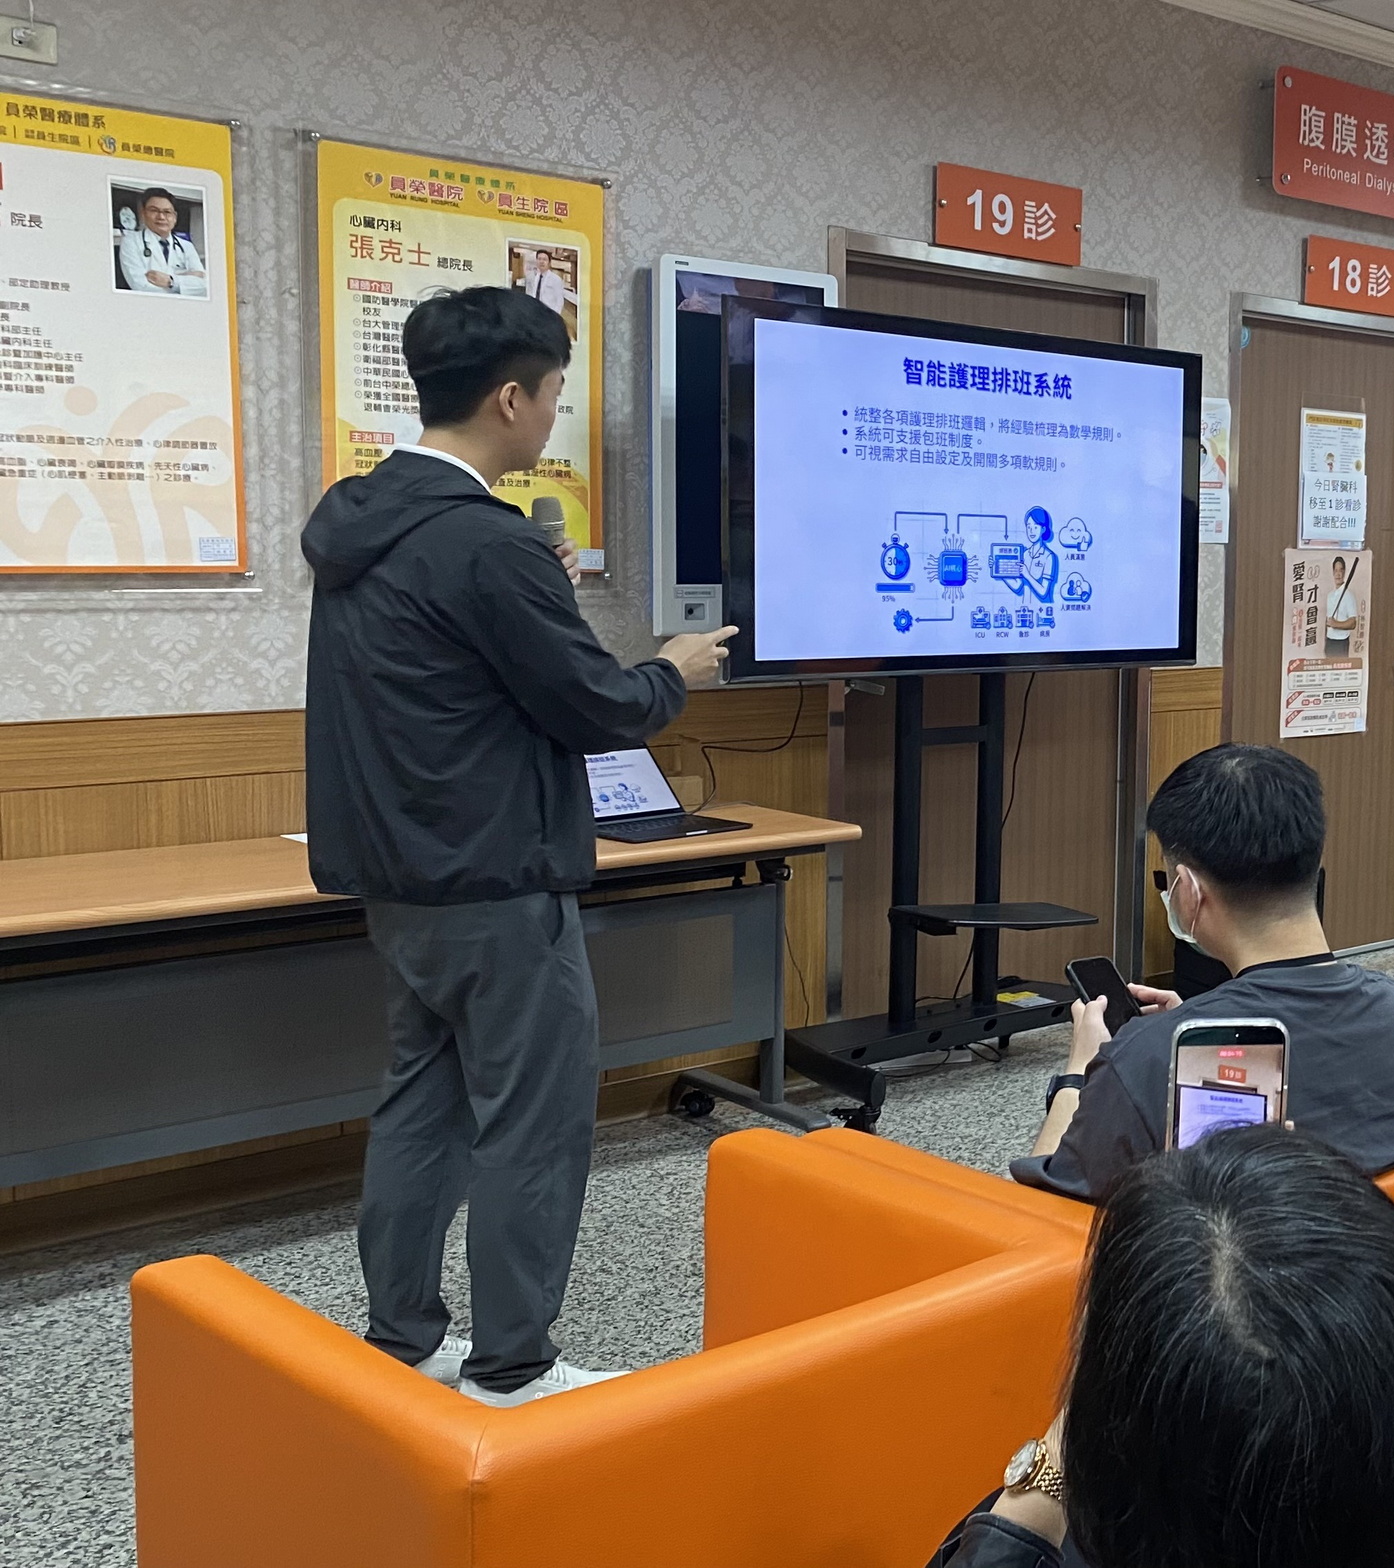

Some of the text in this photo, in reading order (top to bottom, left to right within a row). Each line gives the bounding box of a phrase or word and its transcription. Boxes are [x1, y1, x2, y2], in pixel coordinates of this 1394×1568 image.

[6, 101, 106, 130] 員榮醫療體系
[429, 168, 516, 191] 員榮醫療體系
[1302, 158, 1361, 187] Peritoneal
[390, 175, 464, 201] 員榮醫院
[389, 192, 407, 201] YUAN
[431, 198, 460, 209] HOSPITAL
[498, 192, 569, 217] 員生院區
[10, 211, 43, 229] 院長
[349, 214, 402, 233] 心臟內科
[966, 188, 1057, 241] 19診
[349, 233, 474, 272] 張克士 總院長
[349, 278, 392, 294] 醫師介紹
[1328, 256, 1393, 299] 18診
[362, 294, 422, 309] 國防醫學院醫
[362, 307, 382, 317] 校友
[362, 319, 405, 332] 台大管理
[0, 336, 53, 348] 臟內科主任
[362, 331, 404, 343] 台灣醫院
[362, 343, 403, 355] 彰化縣醫
[0, 360, 74, 373] 科臨床訓練醫師
[903, 356, 1073, 401] 智能護理排班系統
[0, 383, 44, 395] 專科醫師
[853, 405, 1122, 443] 統整各項護理排班邏輯，將經驗梳理為數學規則。
[350, 432, 394, 445] 主治項目
[854, 425, 983, 450] 系統可支援包班制度。
[354, 459, 378, 470] 冠狀
[854, 444, 1067, 473] 可視需求自由設定及開關多項軟規則。
[1314, 478, 1358, 494] 今日腎臟科
[1292, 560, 1306, 604] 愛腎
[1305, 583, 1319, 647] 才會贏
